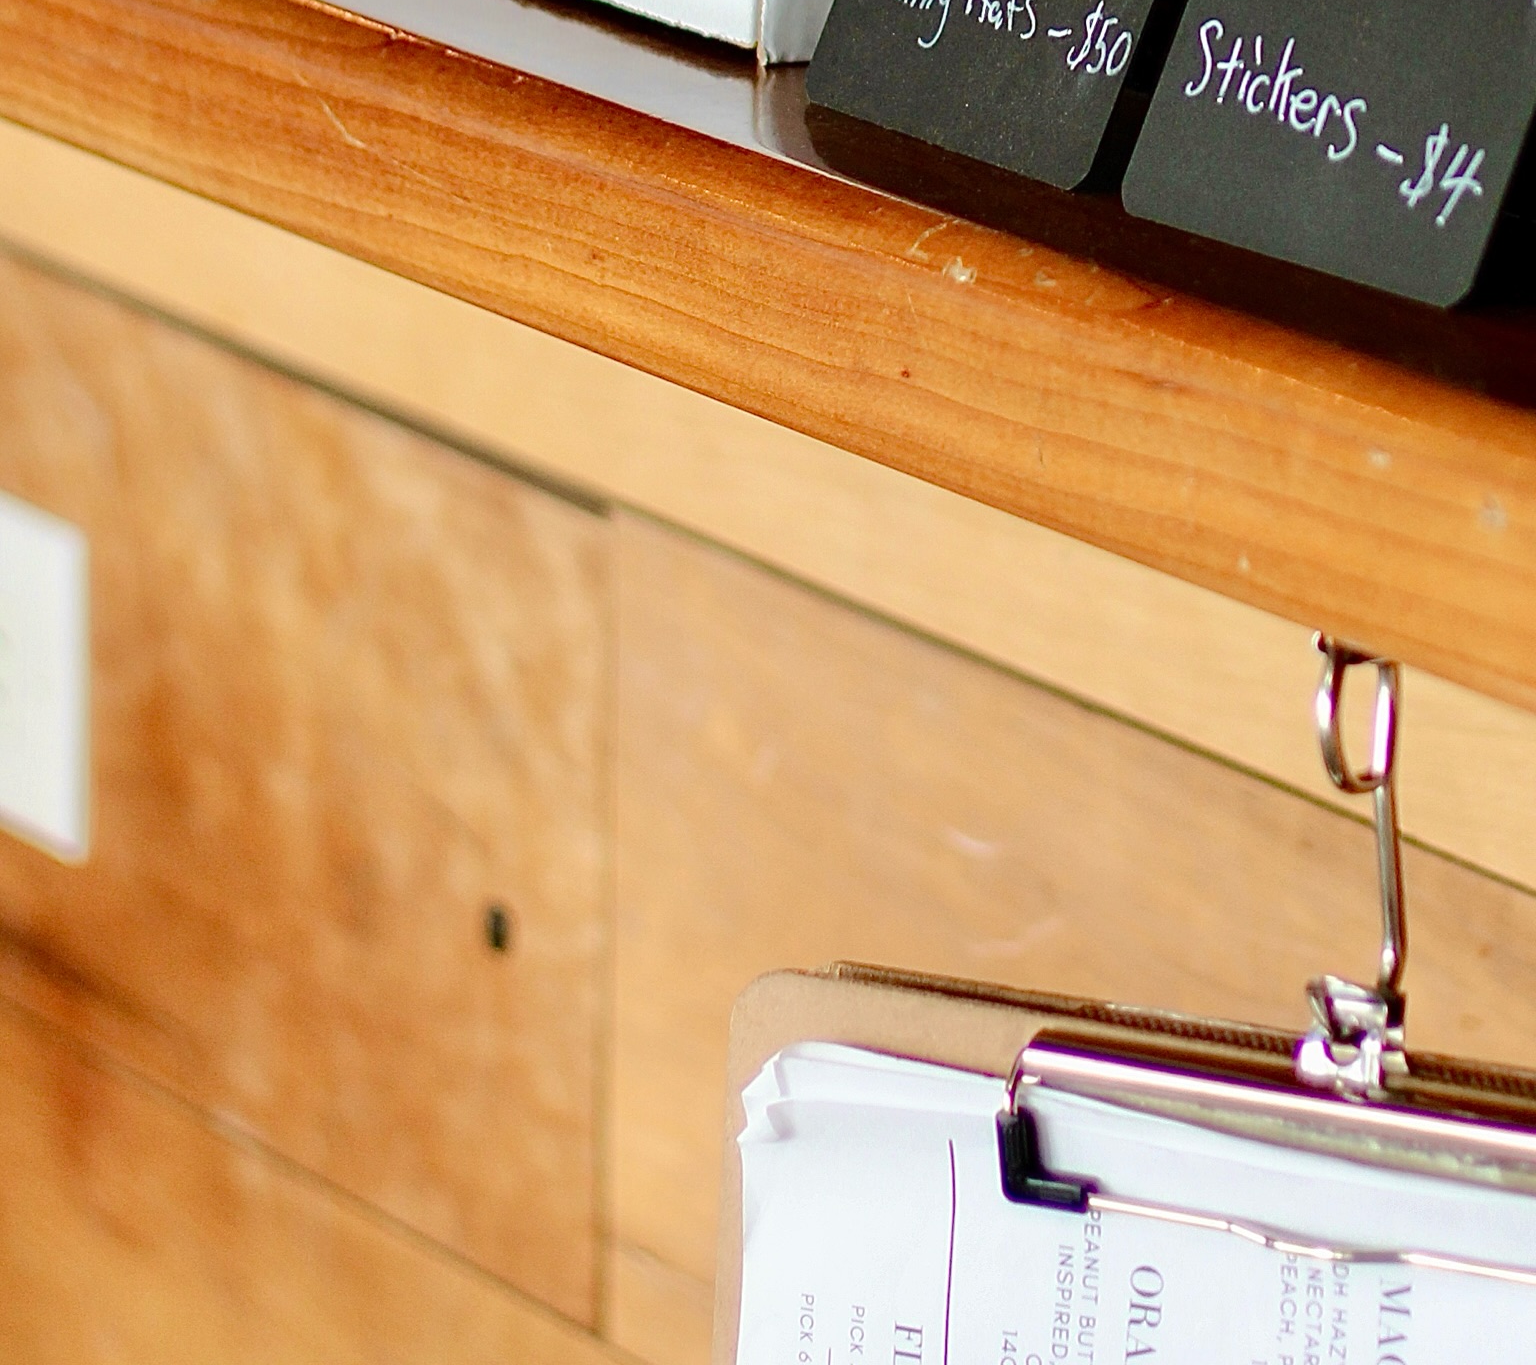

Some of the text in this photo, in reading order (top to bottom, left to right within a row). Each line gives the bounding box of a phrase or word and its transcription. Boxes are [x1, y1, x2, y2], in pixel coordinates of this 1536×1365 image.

[1185, 19, 1367, 161] Stickers
[1081, 1210, 1102, 1305] PEANUT
[799, 1293, 815, 1342] PICK
[849, 1305, 866, 1356] PICK
